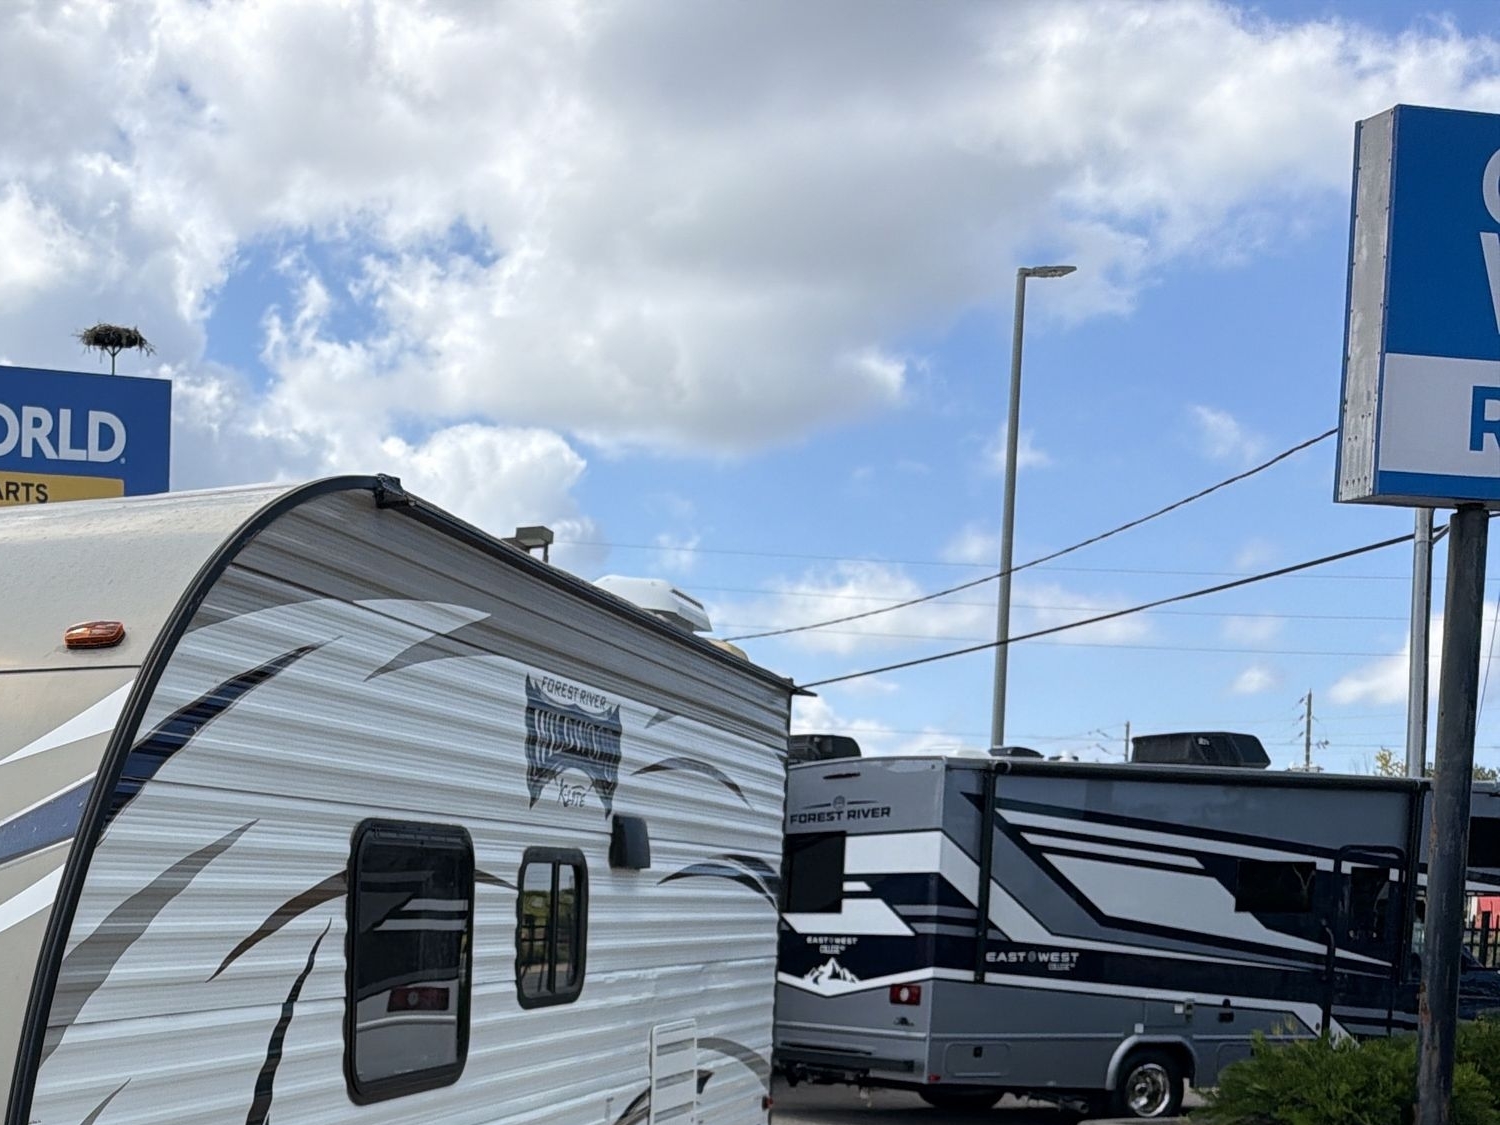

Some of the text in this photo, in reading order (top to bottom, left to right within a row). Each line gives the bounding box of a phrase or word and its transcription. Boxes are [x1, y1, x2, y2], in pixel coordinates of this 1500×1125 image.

[542, 676, 607, 709] FOREST RIVER
[790, 806, 891, 825] FOREST RIVER
[985, 951, 1079, 963] EAST WEST
